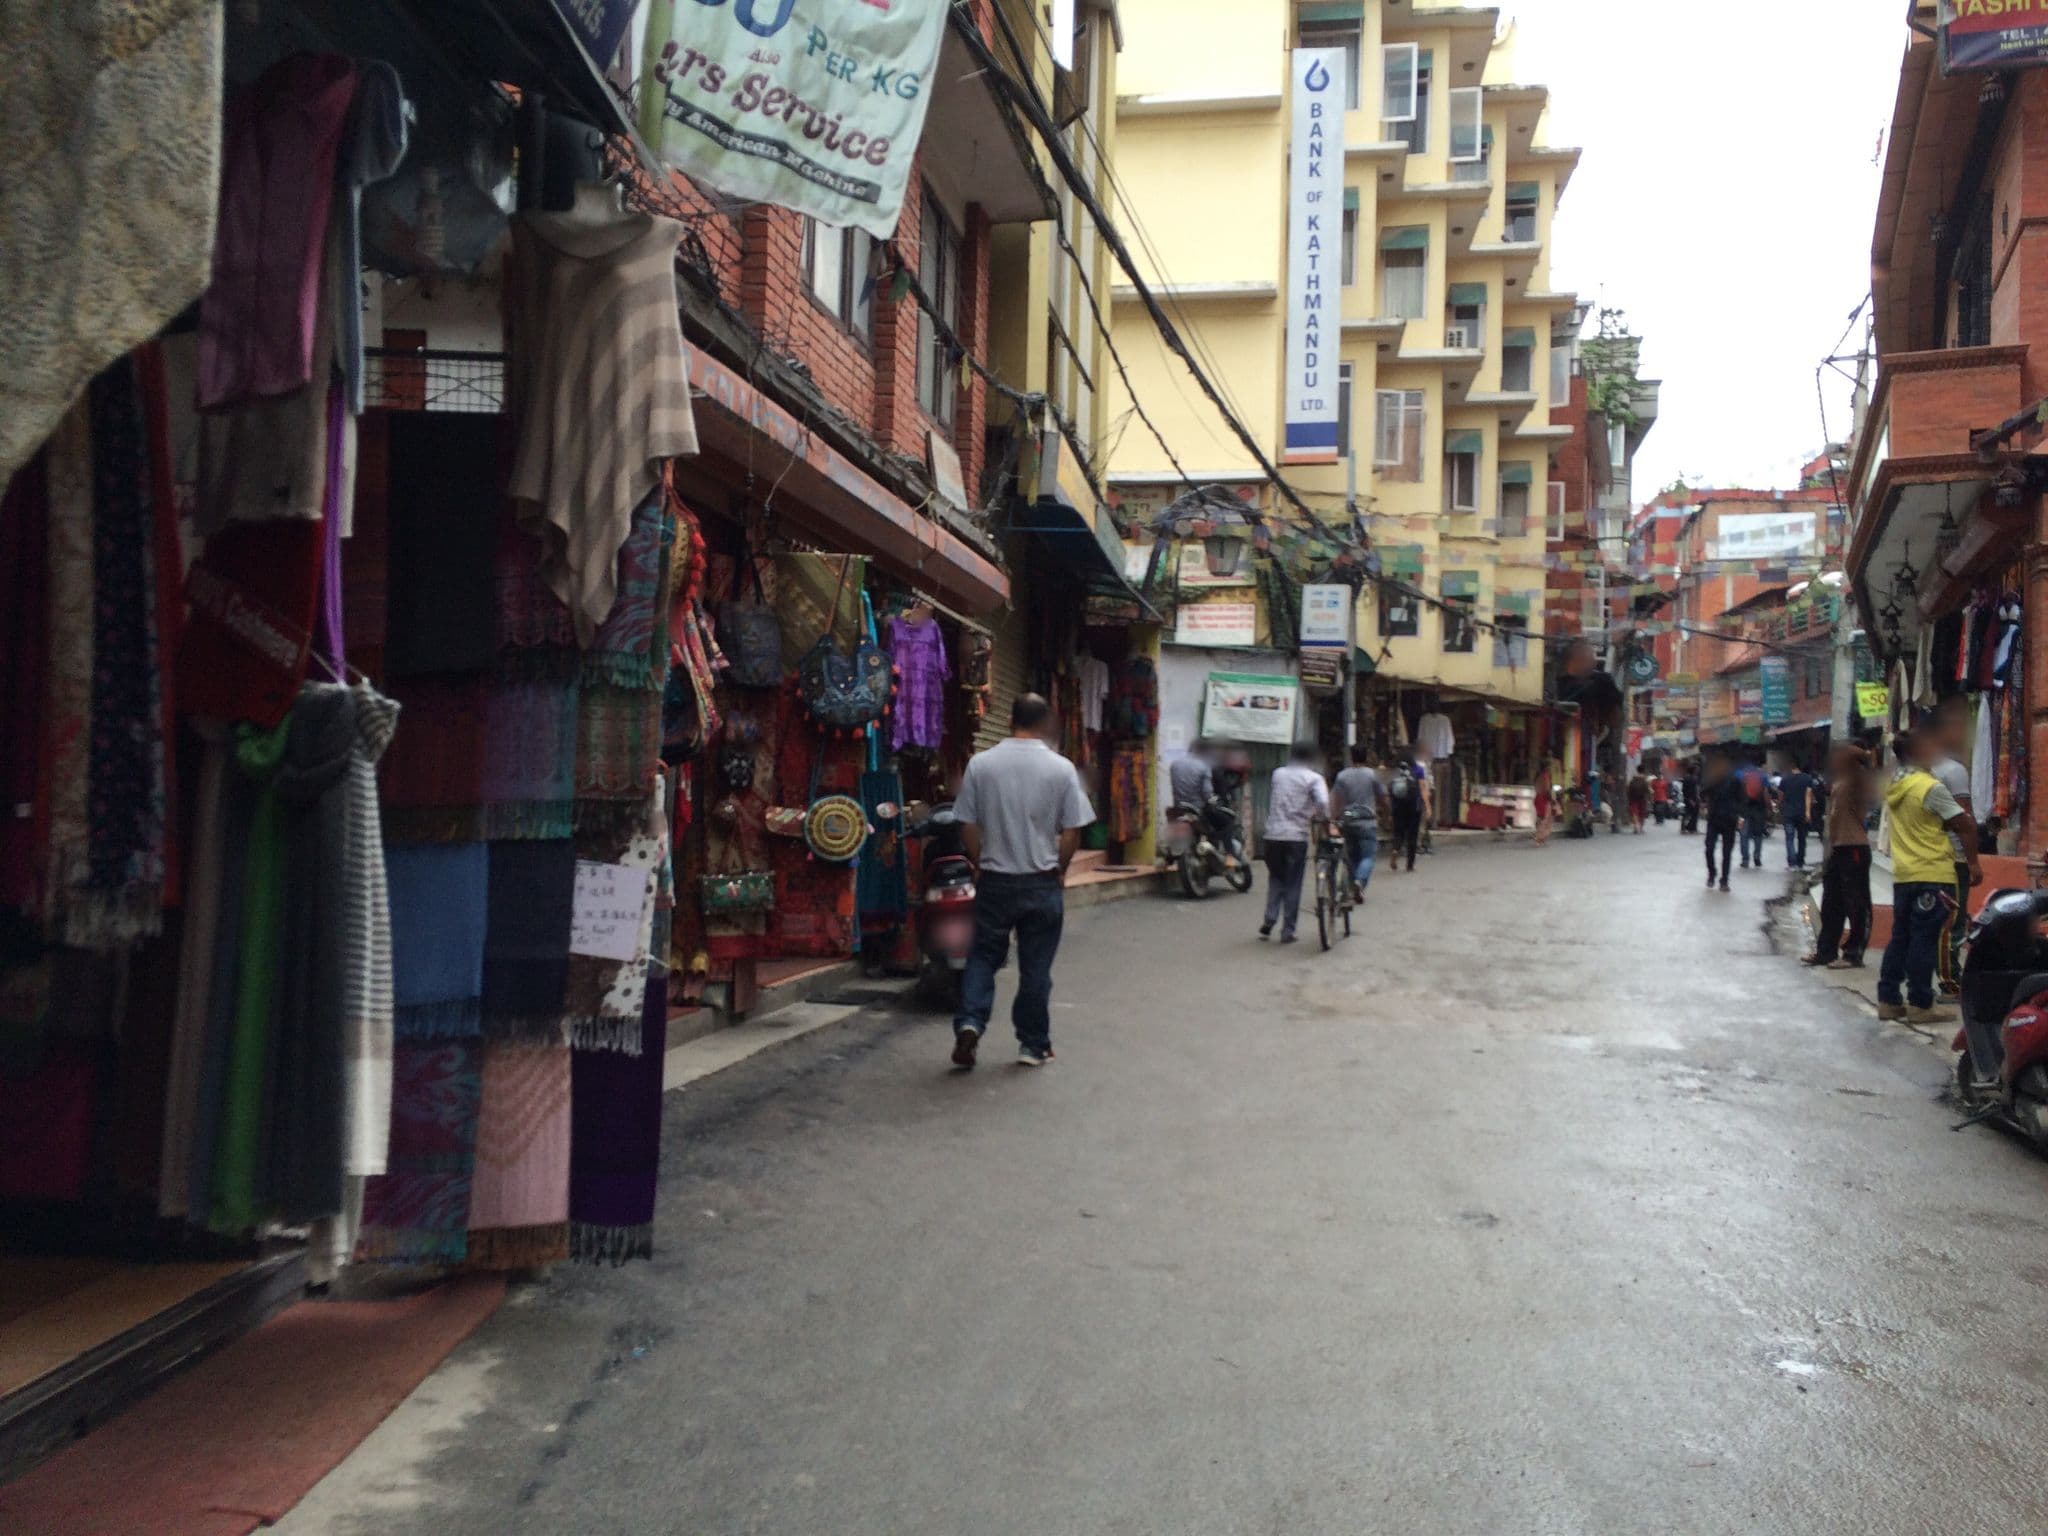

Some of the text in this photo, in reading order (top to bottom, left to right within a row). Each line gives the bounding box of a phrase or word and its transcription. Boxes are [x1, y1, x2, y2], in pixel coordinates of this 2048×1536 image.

[806, 25, 920, 99] PER KG
[2000, 28, 2030, 40] TEL
[731, 73, 890, 166] Service
[1309, 102, 1323, 178] BANK
[1307, 191, 1323, 203] OF
[1304, 215, 1322, 388] KATHMANDU
